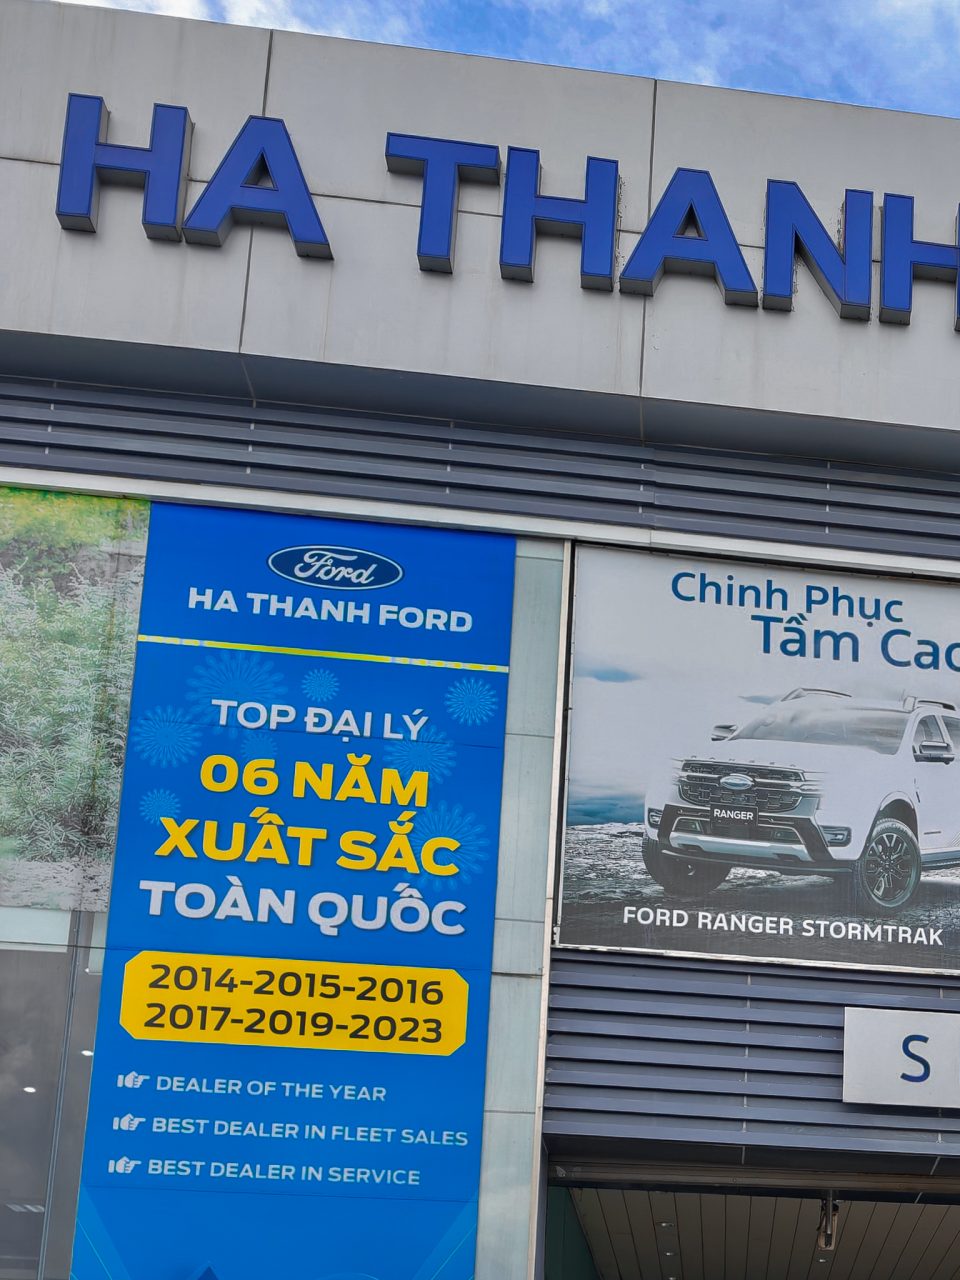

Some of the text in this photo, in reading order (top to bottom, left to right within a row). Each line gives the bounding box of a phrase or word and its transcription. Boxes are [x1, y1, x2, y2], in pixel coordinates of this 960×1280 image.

[55, 92, 333, 261] HA
[294, 547, 378, 586] Ford
[187, 586, 473, 634] HA THANH FORD
[671, 571, 903, 627] Chinh Phục
[751, 613, 860, 663] Tầm
[211, 699, 429, 743] TOP ĐẠI LÝ
[199, 754, 430, 808] 06 NĂM
[713, 808, 754, 821] RANGER
[153, 807, 462, 877] XUẤT SẮC
[138, 875, 467, 937] TOÀN QUỐC
[622, 906, 943, 946] FORD RANGER STORMTRAK
[148, 964, 444, 1006] 2014-2015-2016
[143, 1003, 443, 1044] 2017-2019-2023
[156, 1075, 387, 1102] DEALER OF THE YEAR
[152, 1117, 469, 1147] BEST DEALER IN FLEET SALES
[148, 1159, 421, 1185] BEST DEALER IN SERVICE
